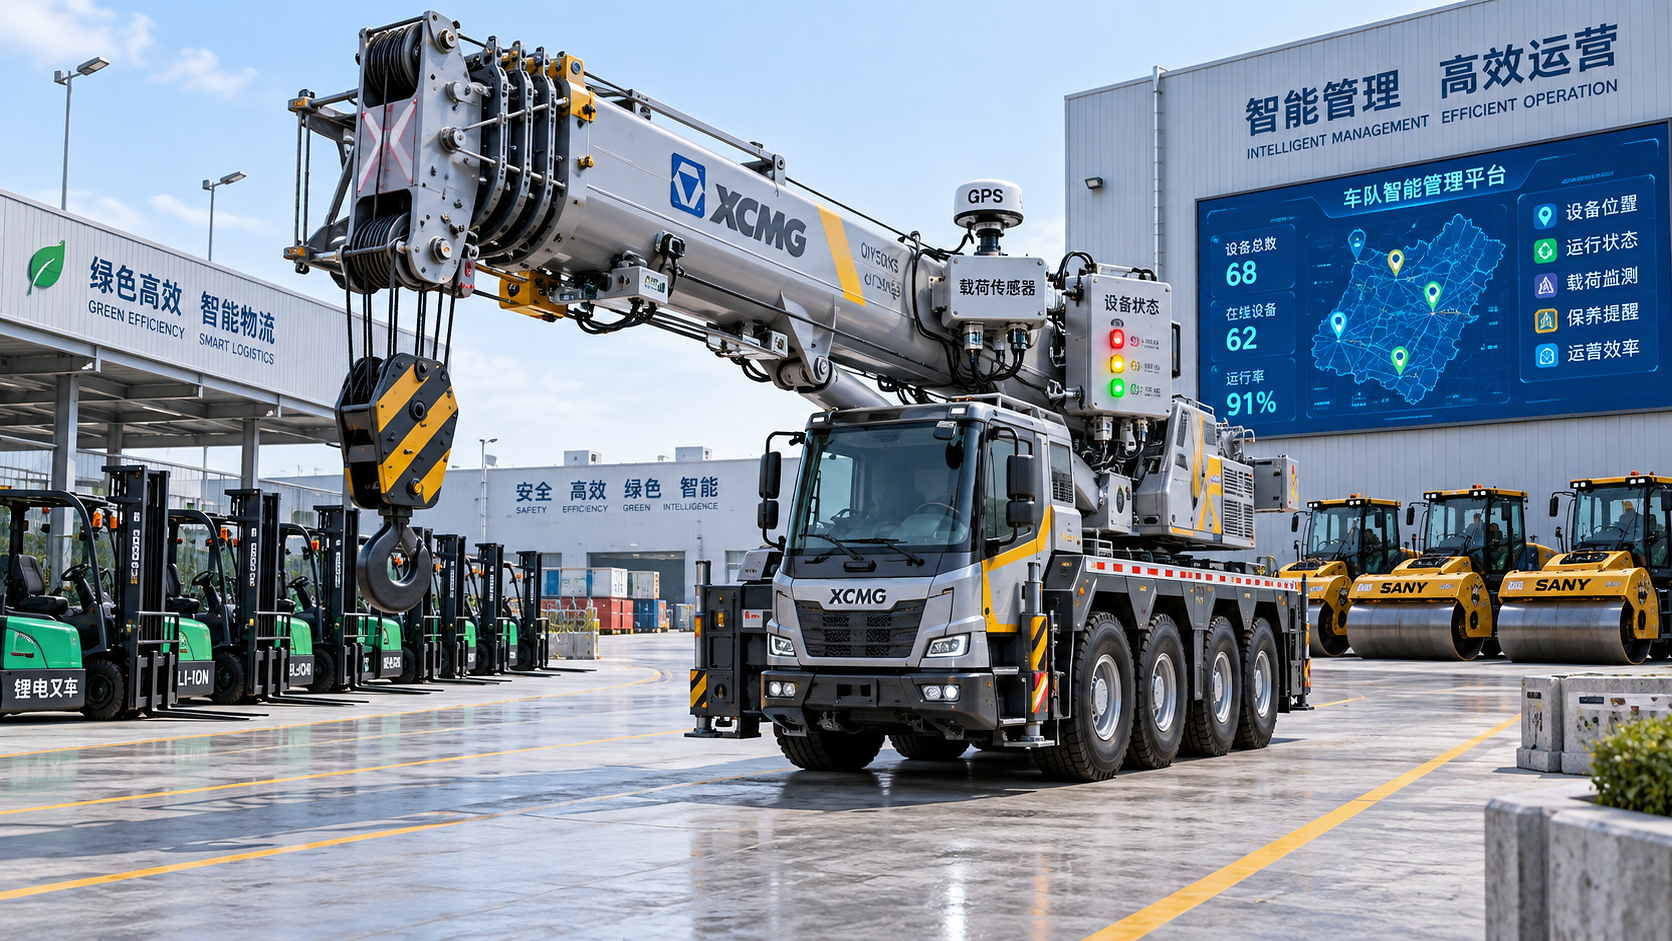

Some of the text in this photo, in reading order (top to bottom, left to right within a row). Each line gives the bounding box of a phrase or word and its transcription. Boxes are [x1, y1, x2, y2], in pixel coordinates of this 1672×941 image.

[1245, 23, 1618, 137] 智能管理 高效运营
[1247, 78, 1618, 159] INTELLIGENT MANAGEMENT EFFICIENT OPERATION
[967, 188, 1004, 205] GPS
[1343, 163, 1507, 209] 车队智能管理平台
[709, 183, 807, 258] XCMG
[1566, 231, 1638, 257] 运行状态
[1226, 260, 1257, 287] 68
[89, 255, 275, 345] 绿色高效 智能物流
[959, 278, 1036, 297] 载荷传感器
[1104, 294, 1160, 316] 设备状态
[1567, 302, 1639, 327] 保养提醒
[88, 299, 275, 365] GREEN EFFICIENCY SMART LOGISTICS
[1226, 325, 1257, 351] 62
[1226, 390, 1276, 416] 91%
[516, 476, 718, 502] 安全 高效 绿色 智能
[516, 502, 718, 515] SAFETY EFFICIENCY GREEN INTELLIGENCE
[828, 588, 887, 605] XCMG
[1380, 581, 1428, 594] SANY
[1535, 578, 1592, 592] SANY
[178, 669, 209, 686] LI-ION
